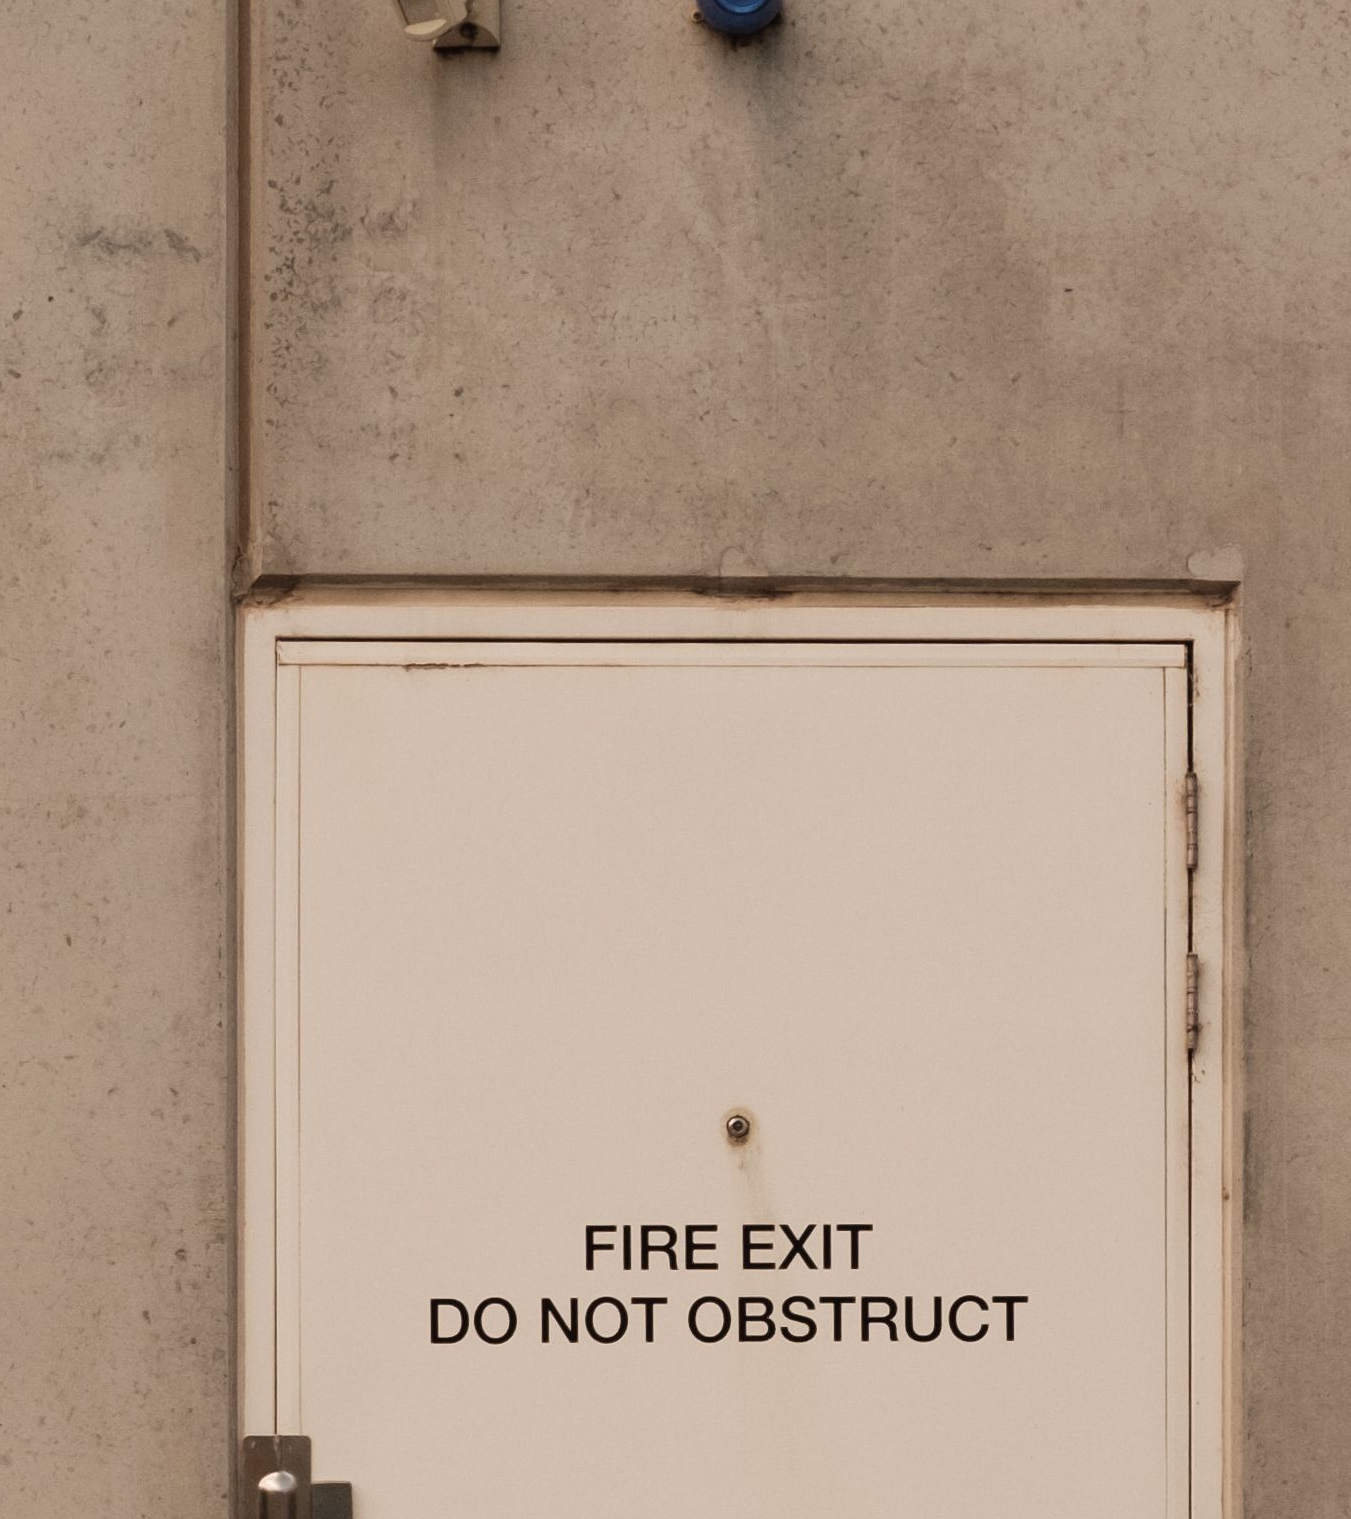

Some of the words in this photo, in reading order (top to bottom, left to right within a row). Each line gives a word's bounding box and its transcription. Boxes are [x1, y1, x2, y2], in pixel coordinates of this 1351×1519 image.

[585, 1224, 719, 1271] FIRE
[742, 1223, 874, 1270] EXIT
[429, 1296, 518, 1345] DO
[541, 1296, 668, 1345] NOT
[687, 1294, 1029, 1344] OBSTRUCT
